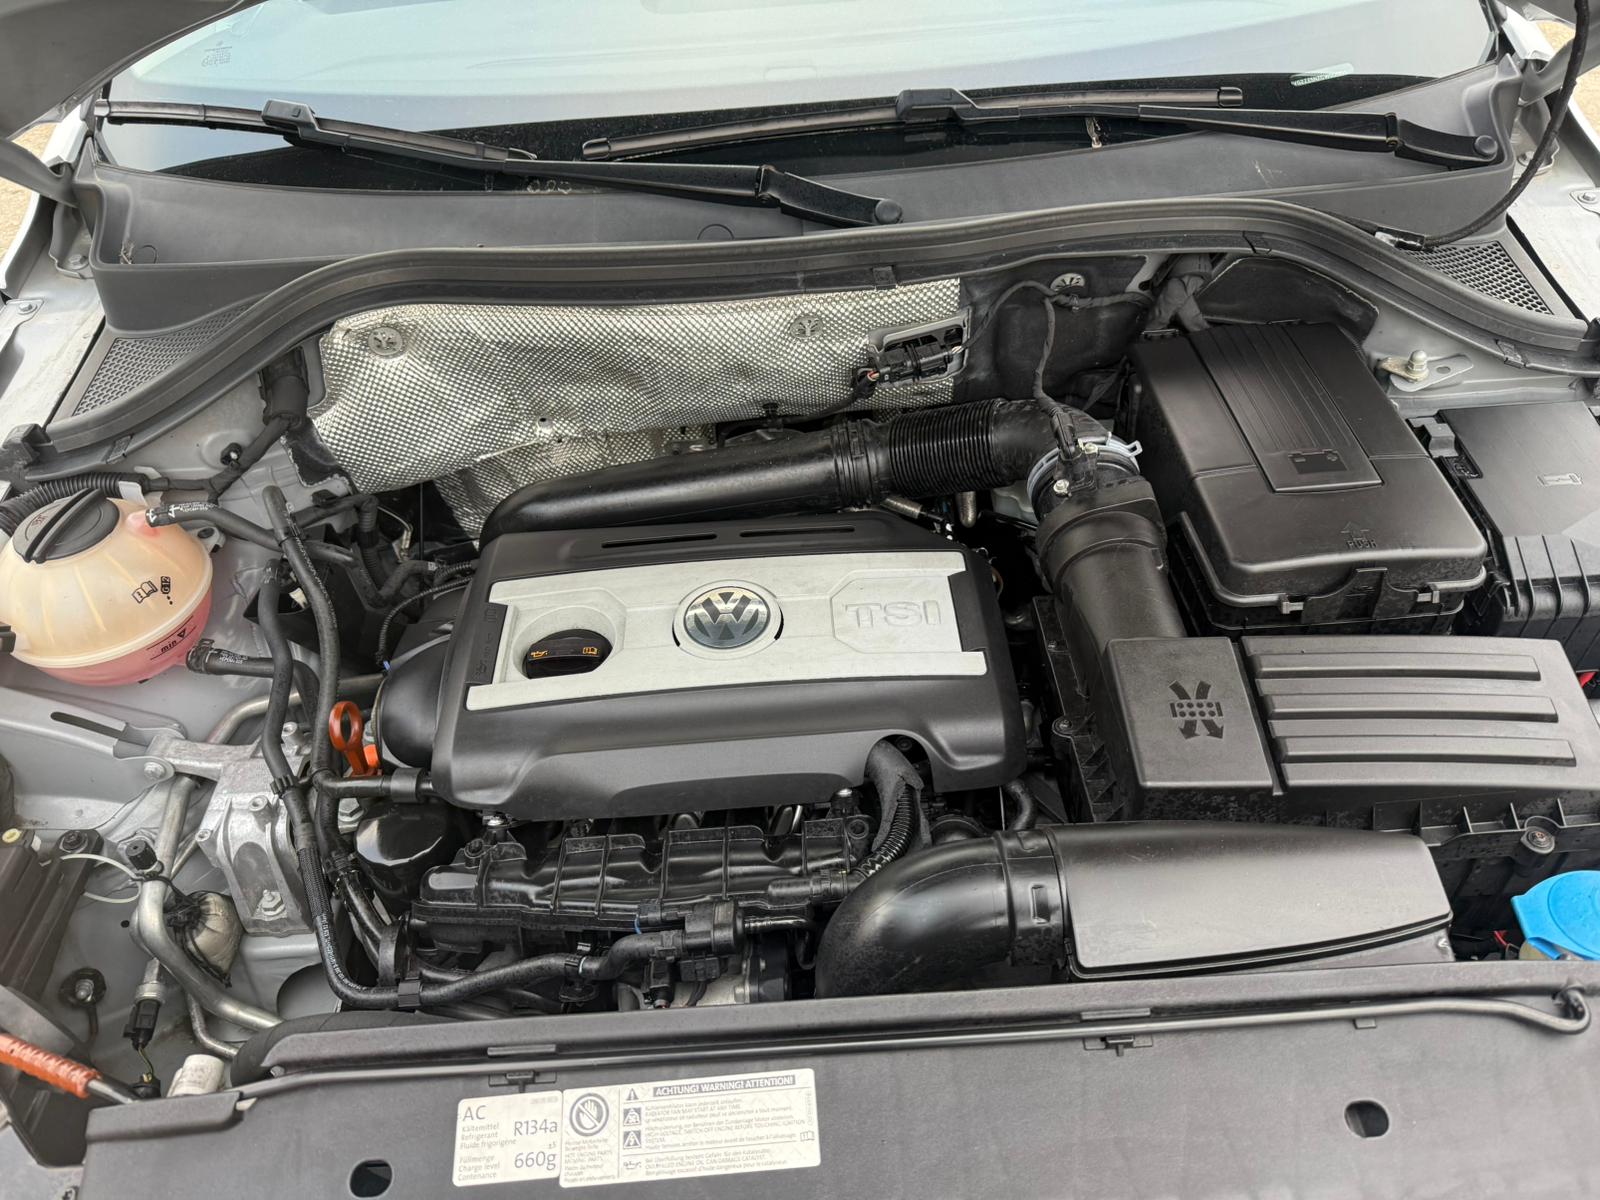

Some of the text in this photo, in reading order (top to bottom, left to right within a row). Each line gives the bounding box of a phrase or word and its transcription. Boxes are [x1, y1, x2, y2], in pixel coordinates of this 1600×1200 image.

[1346, 540, 1376, 548] PUSH
[161, 576, 171, 594] G12
[684, 587, 771, 649] VW
[845, 600, 942, 628] TSI
[160, 640, 177, 653] min
[655, 1075, 793, 1096] ACHTUNG! WARNING! ATTENTION!
[462, 1105, 487, 1121] AC
[513, 1118, 558, 1136] R134a
[514, 1151, 557, 1171] 660g
